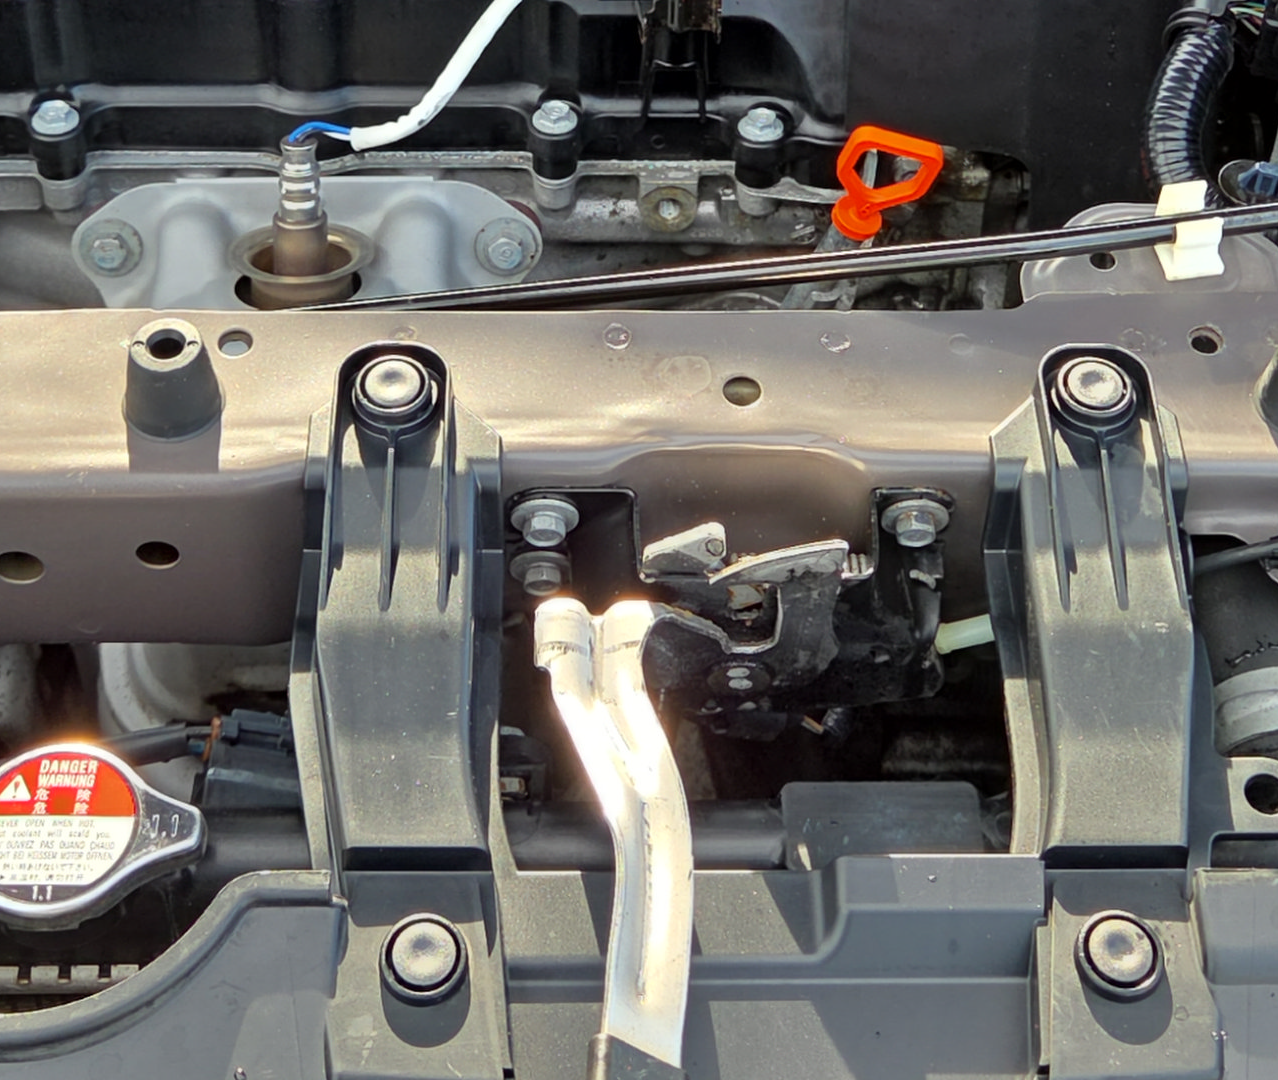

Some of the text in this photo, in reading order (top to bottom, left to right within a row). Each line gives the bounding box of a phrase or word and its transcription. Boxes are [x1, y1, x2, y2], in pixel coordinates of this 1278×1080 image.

[39, 759, 99, 773] DANGER
[37, 773, 96, 788] WARNUNG
[25, 819, 45, 827] OPEN
[52, 819, 73, 827] WHEN
[12, 829, 42, 838] coolant
[47, 829, 63, 838] will
[68, 829, 90, 838] scald
[40, 840, 54, 850] PAS
[32, 885, 53, 901] 1.1
